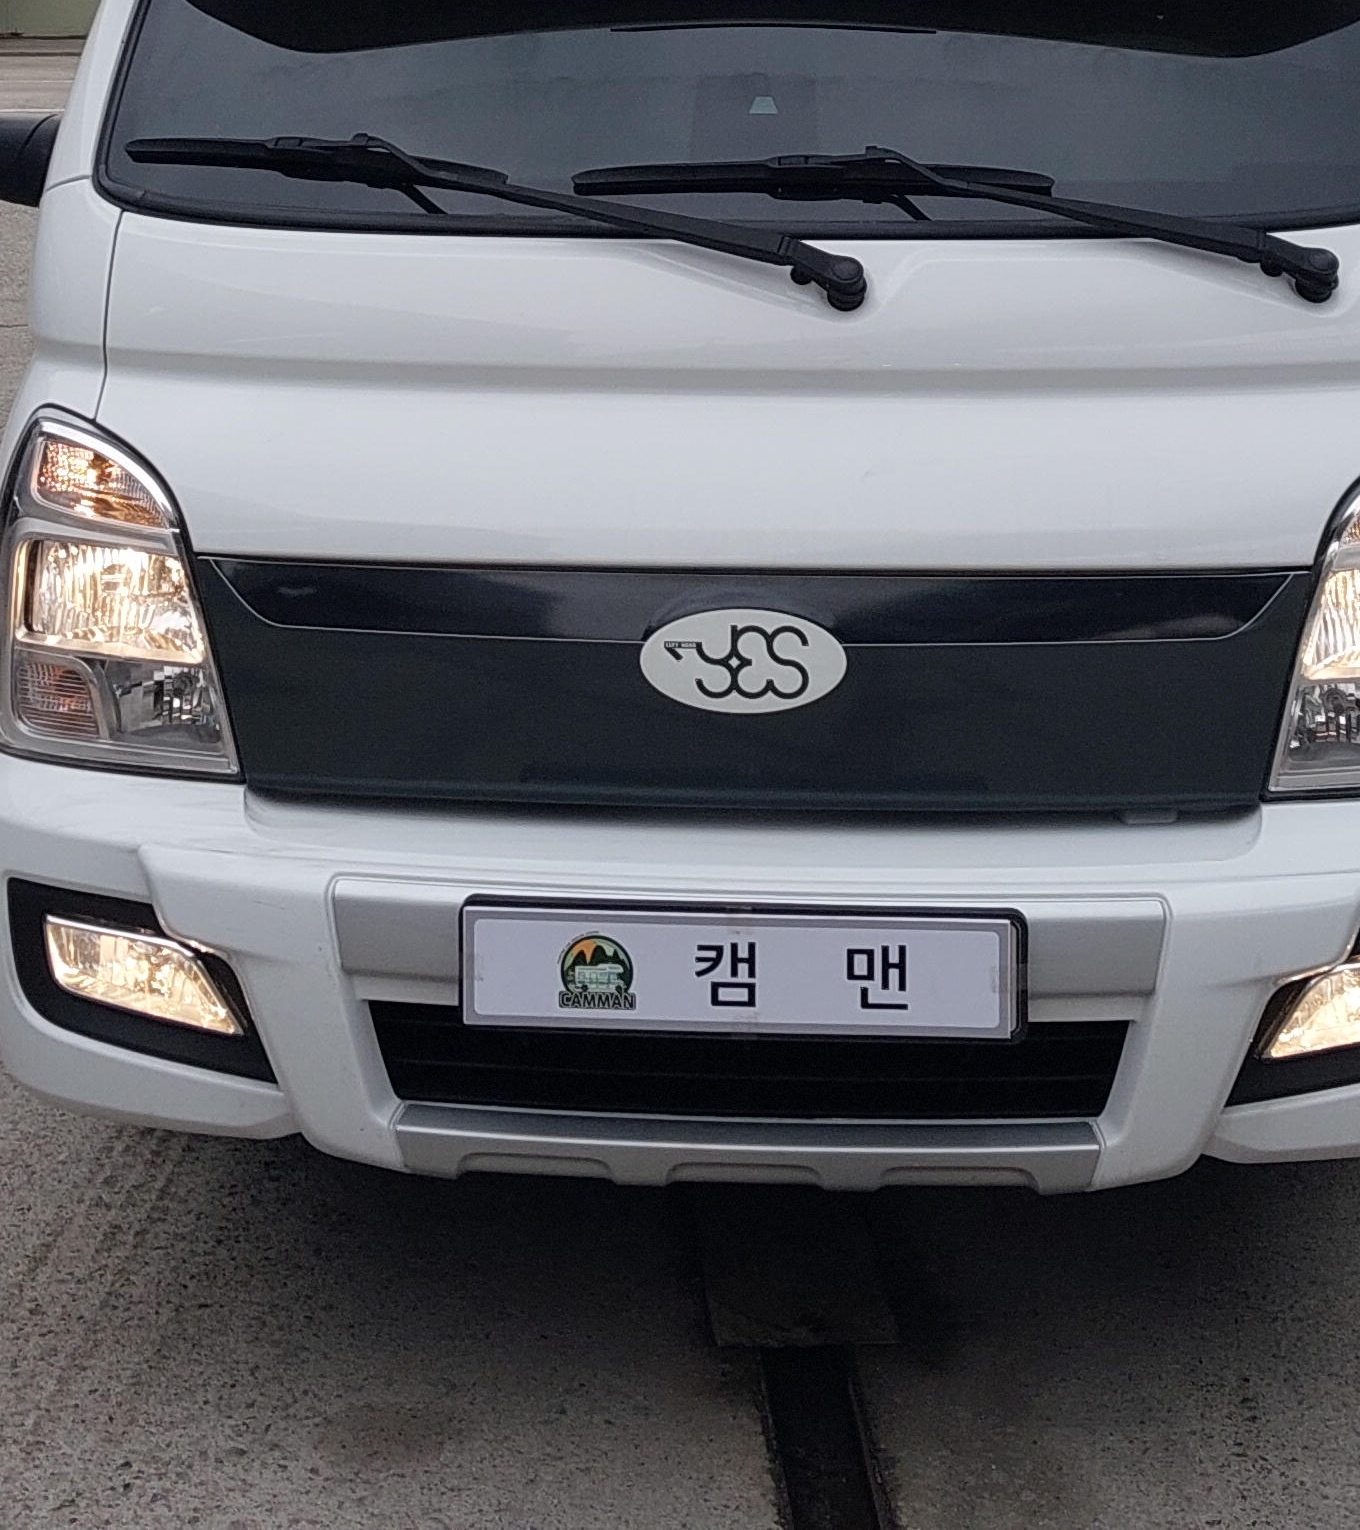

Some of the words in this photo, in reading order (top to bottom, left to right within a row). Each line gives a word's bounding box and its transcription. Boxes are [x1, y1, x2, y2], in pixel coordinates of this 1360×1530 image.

[694, 941, 757, 1008] 캠
[846, 944, 909, 1011] 맨
[559, 991, 636, 1010] CAMMAN
